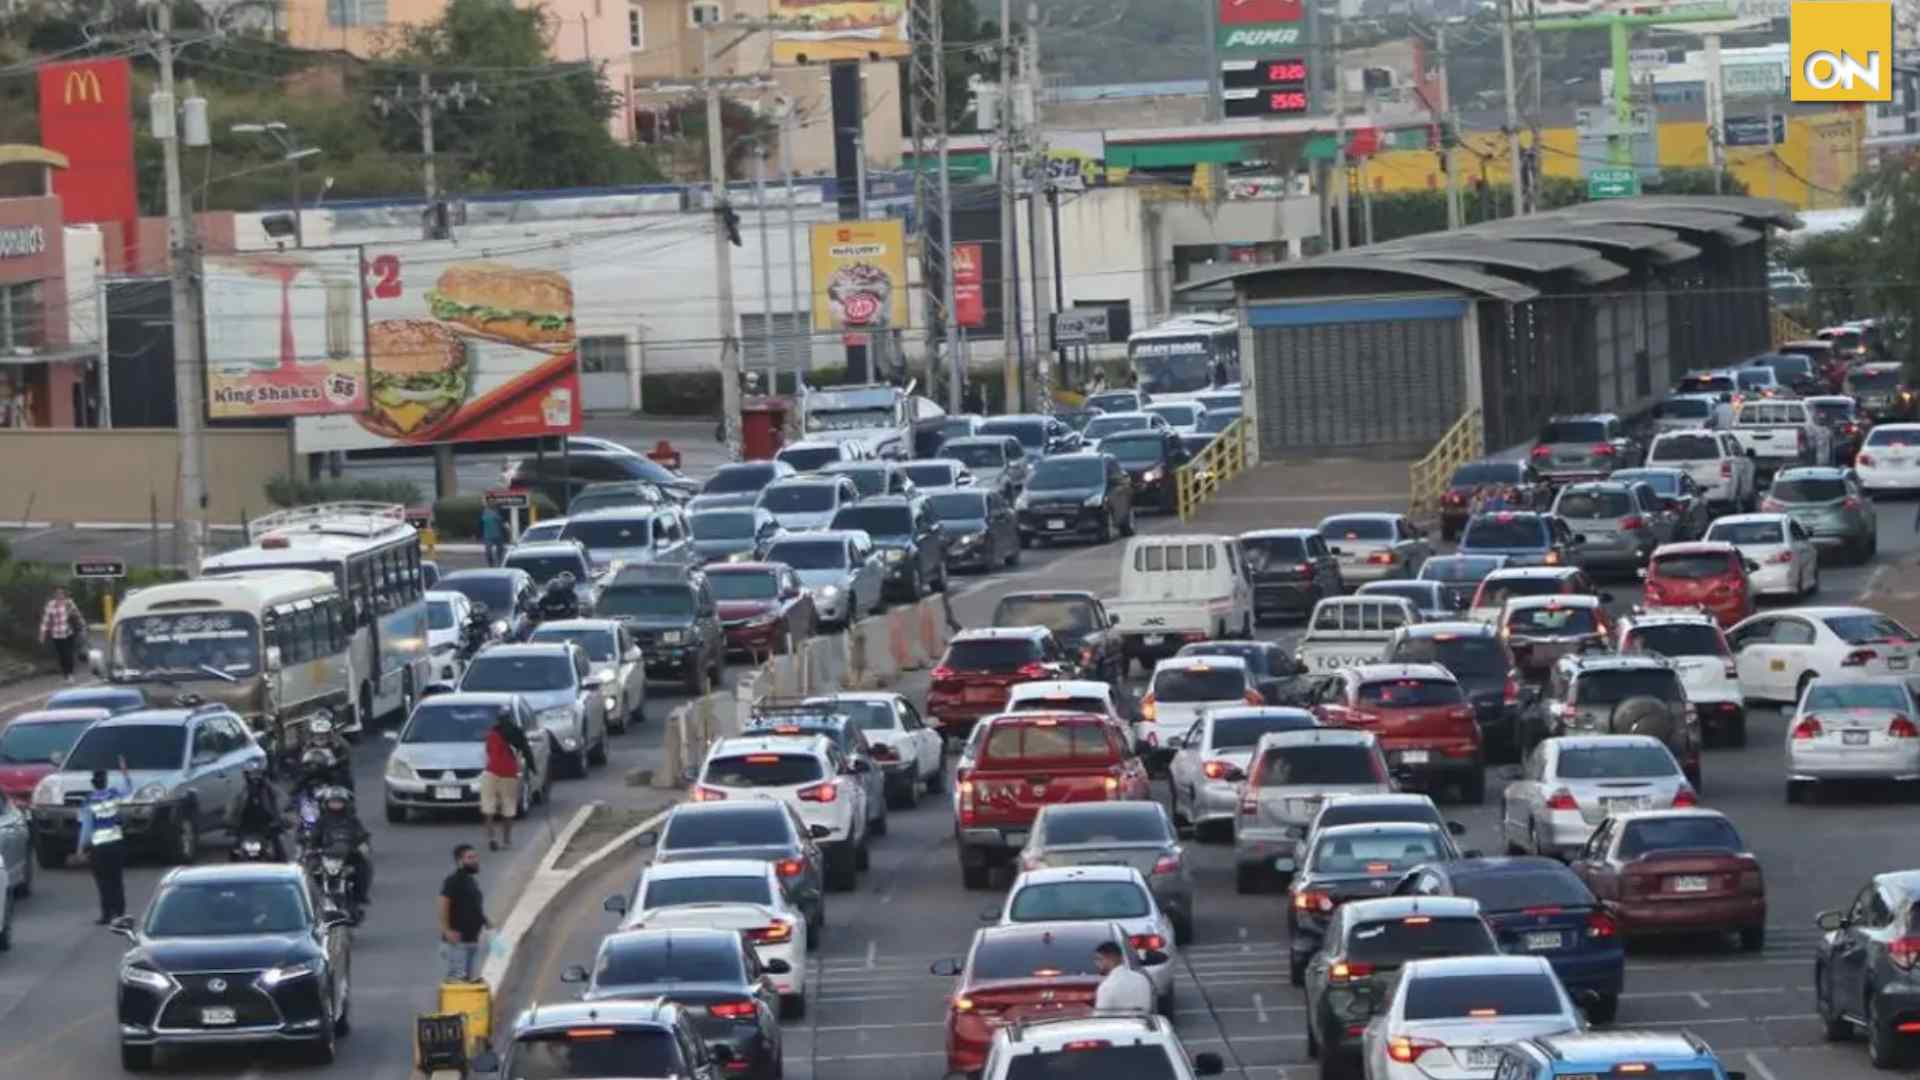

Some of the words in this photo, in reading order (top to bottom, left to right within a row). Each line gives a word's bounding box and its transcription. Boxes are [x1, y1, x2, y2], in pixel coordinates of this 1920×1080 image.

[1226, 28, 1299, 47] PUMA
[1592, 171, 1632, 181] SALIDA
[214, 385, 254, 403] King
[258, 385, 320, 400] Shakes
